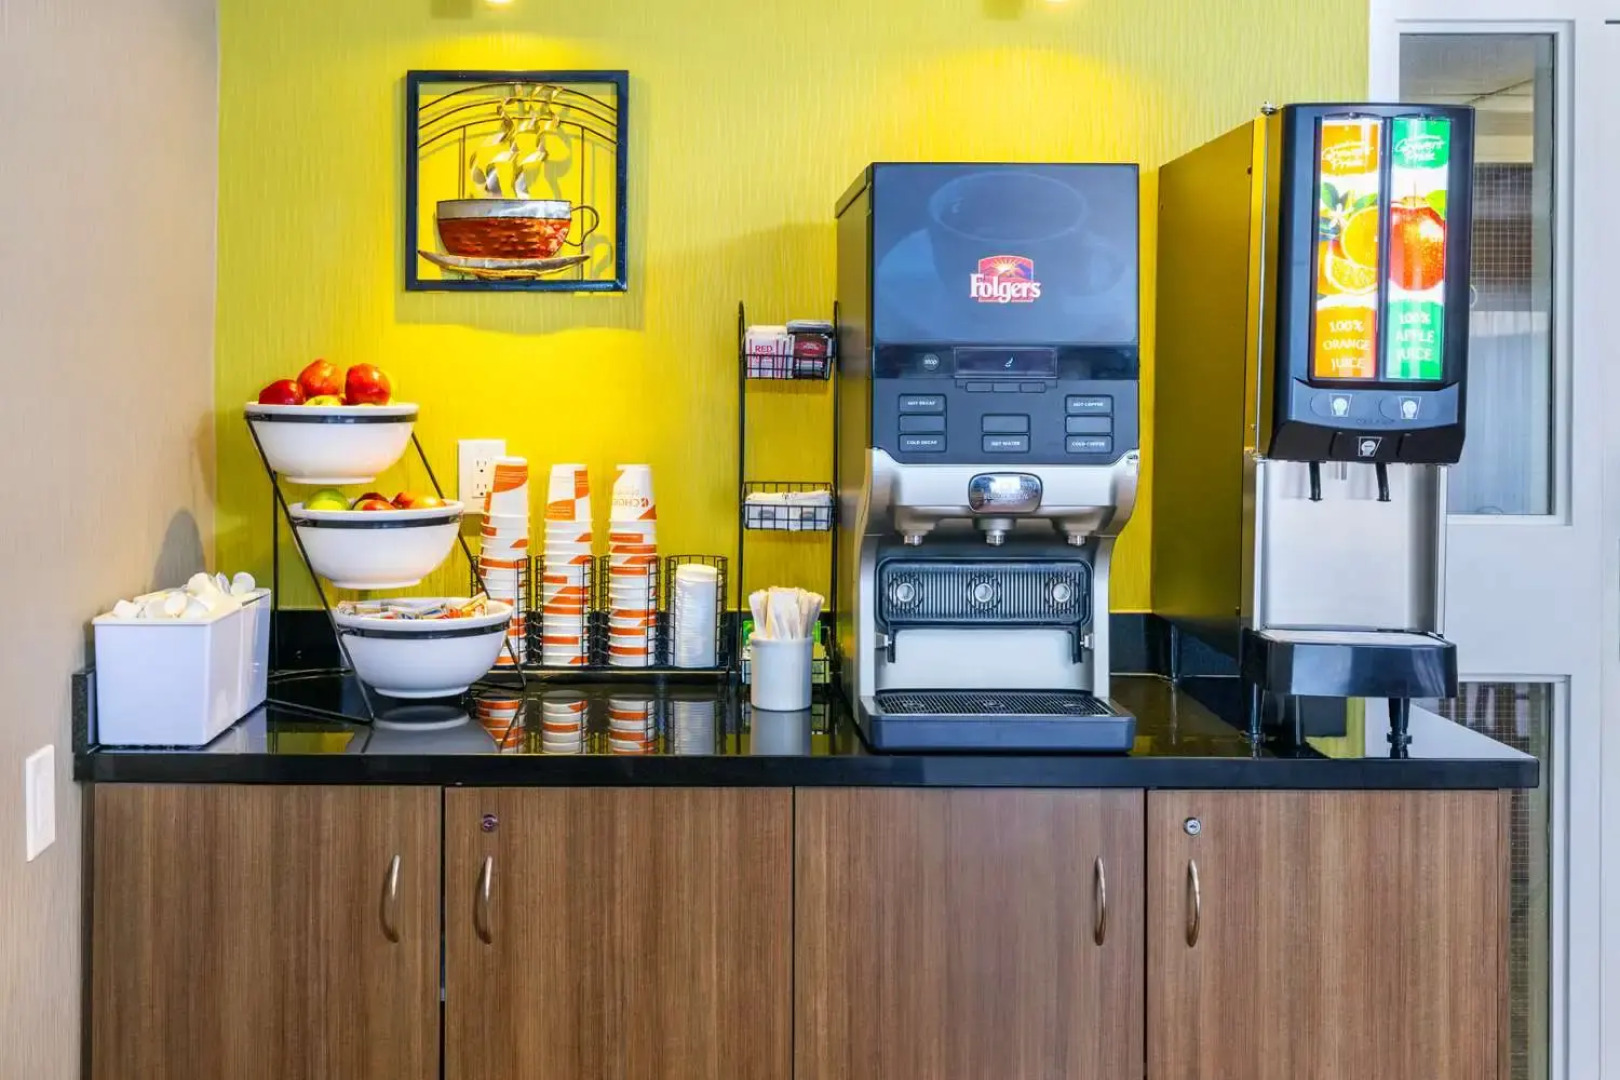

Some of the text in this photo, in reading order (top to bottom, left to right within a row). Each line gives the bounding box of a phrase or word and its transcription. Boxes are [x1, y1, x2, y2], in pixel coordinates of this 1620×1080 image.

[969, 272, 1042, 303] Folgers
[1399, 313, 1431, 324] 100%
[1330, 320, 1364, 332] 100%
[1396, 330, 1434, 342] APPLE
[755, 345, 773, 353] RED
[1322, 338, 1371, 351] ORANGE
[1397, 348, 1433, 363] JUICE
[1330, 356, 1366, 371] JUICE
